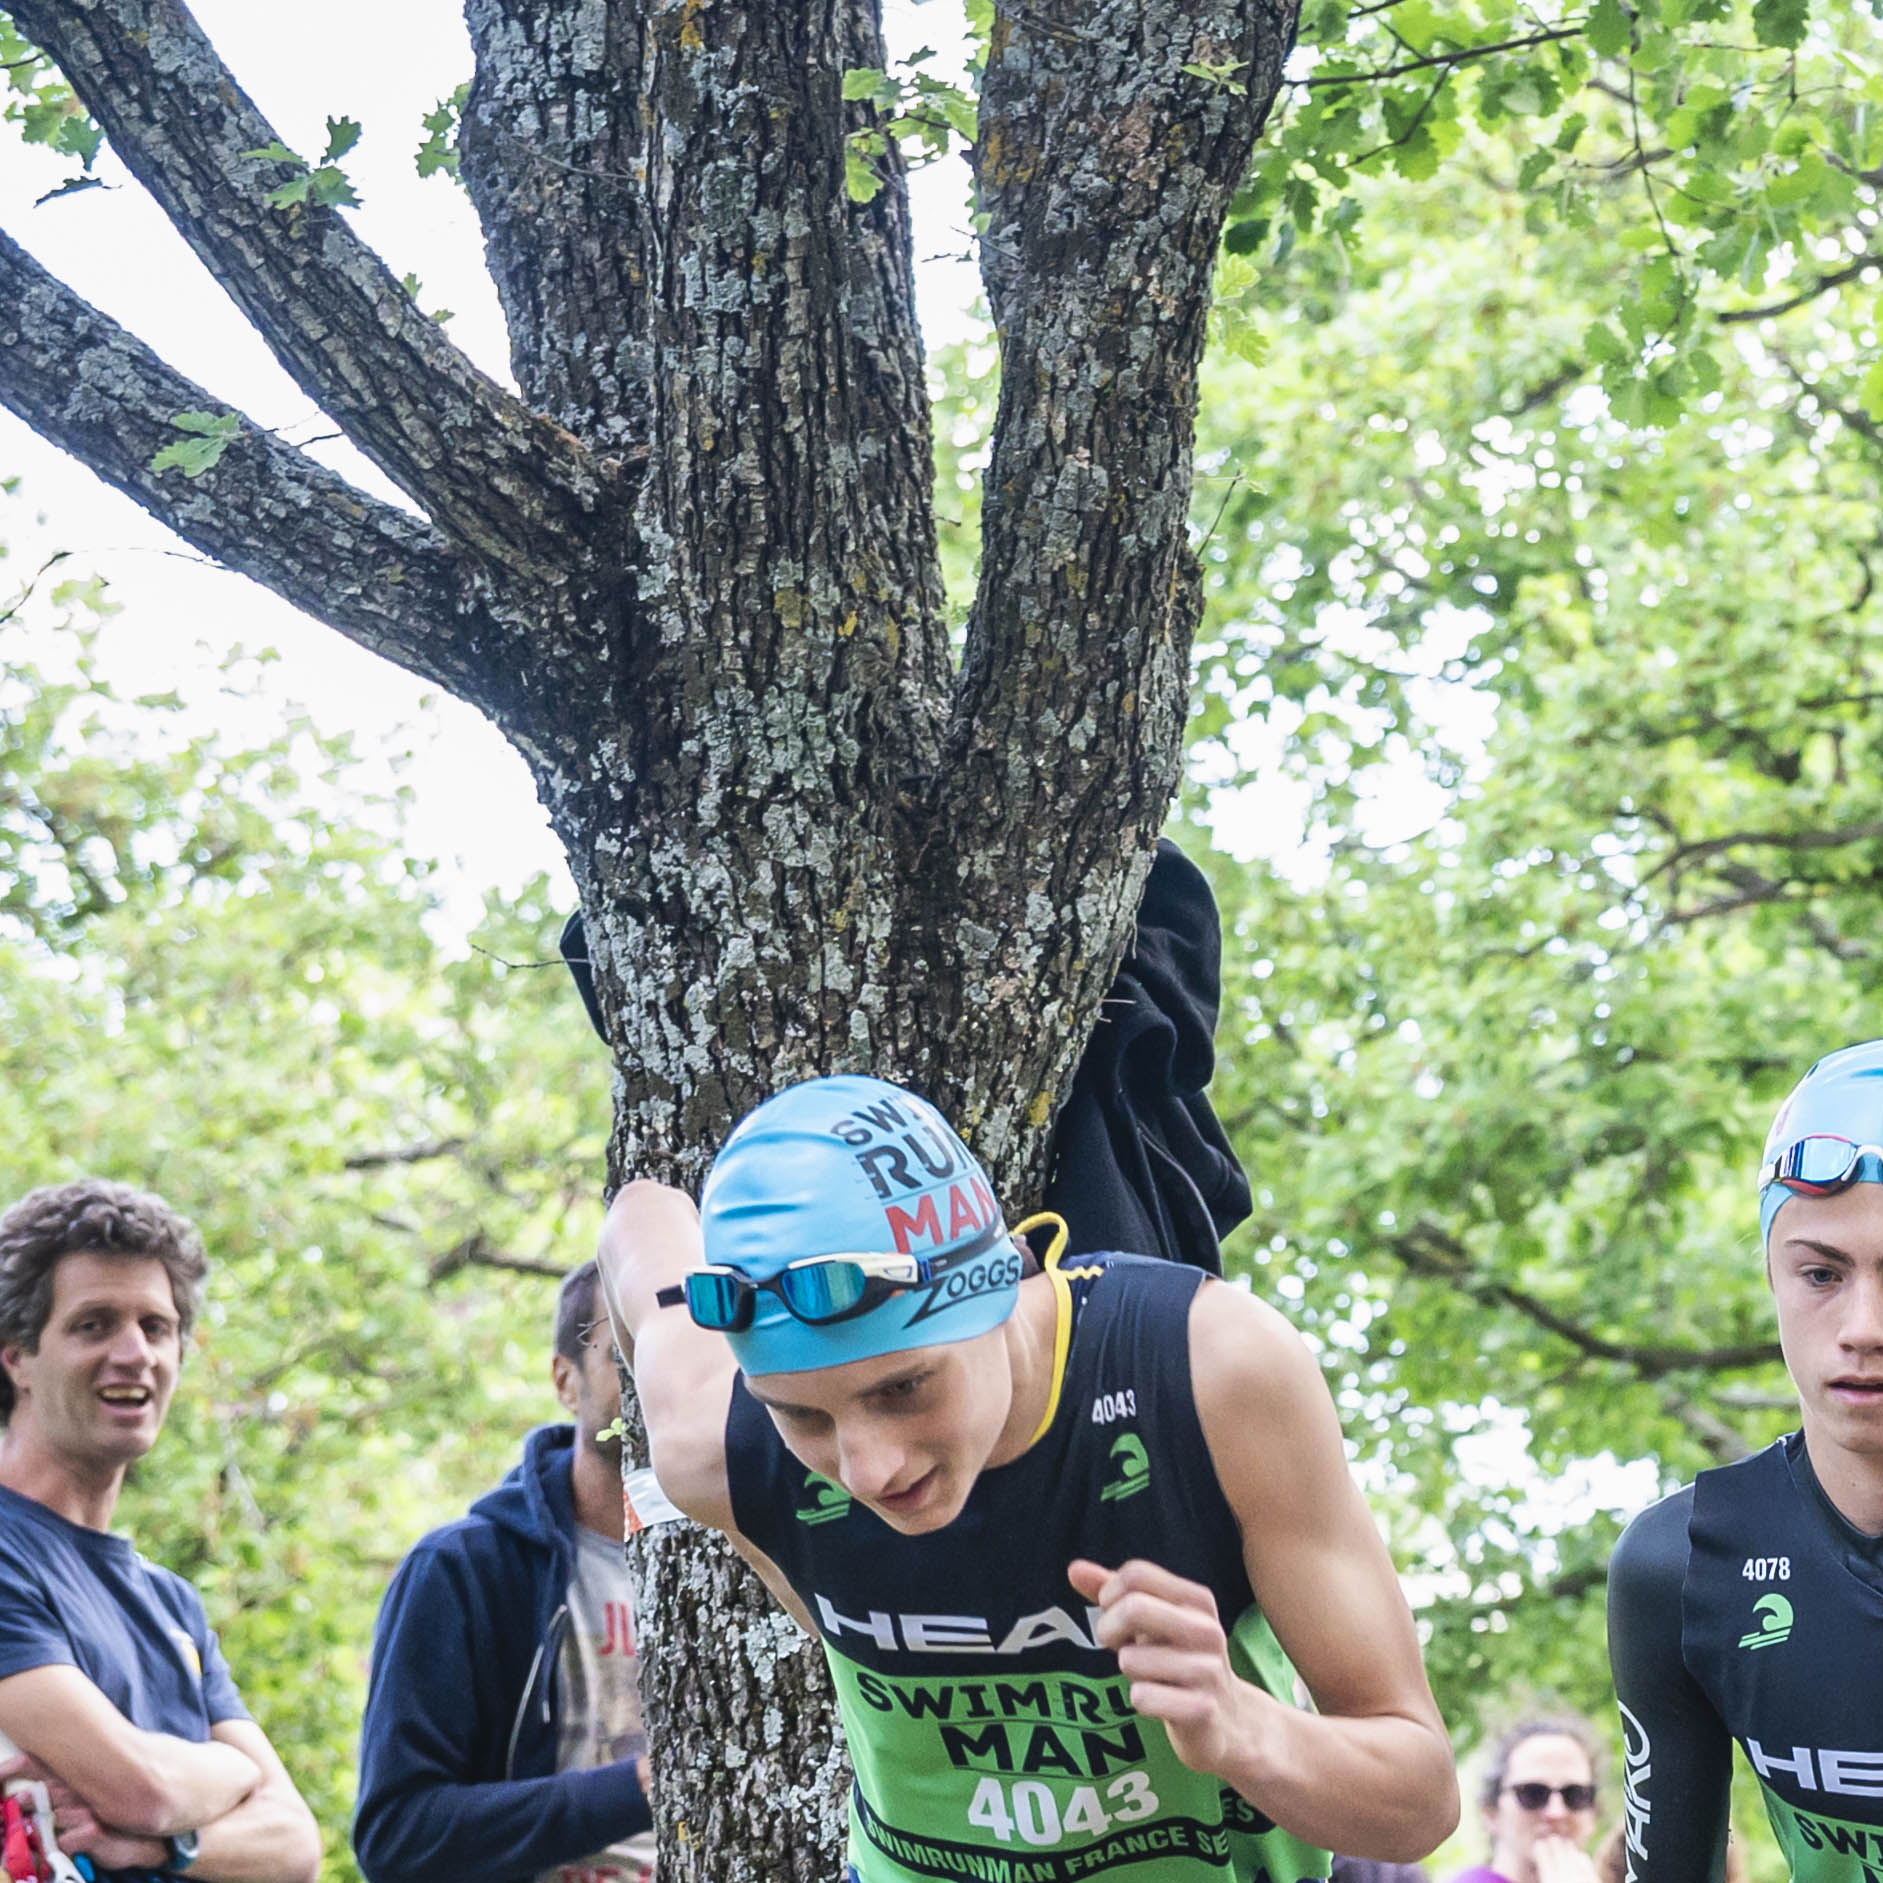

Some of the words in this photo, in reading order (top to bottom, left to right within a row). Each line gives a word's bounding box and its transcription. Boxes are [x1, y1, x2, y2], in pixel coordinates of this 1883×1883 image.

[885, 1176, 997, 1253] MAN
[902, 1255, 1021, 1329] ZOGGS
[1092, 1388, 1136, 1425] 4043
[1742, 1557, 1791, 1582] 4078
[814, 1592, 1106, 1654] HEA
[938, 1721, 1147, 1778] MAN
[968, 1771, 1160, 1846] 4043
[1065, 1826, 1189, 1876] FRANCE
